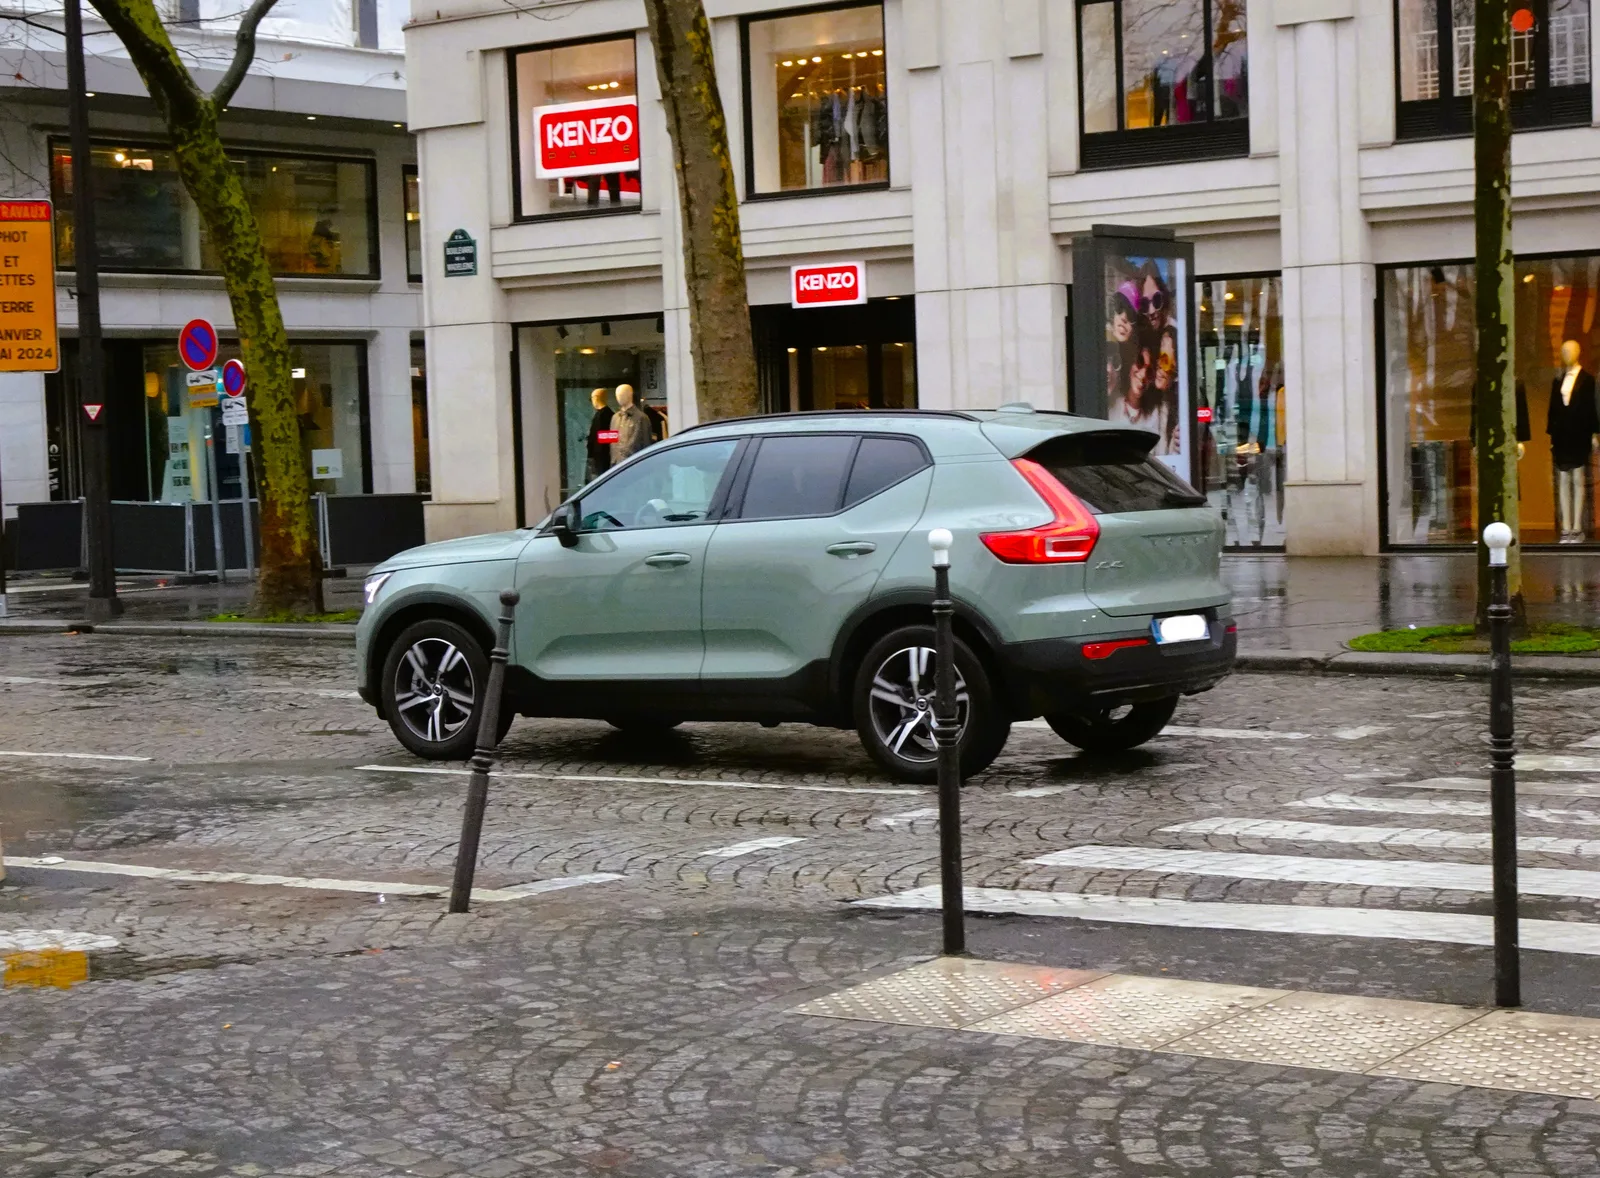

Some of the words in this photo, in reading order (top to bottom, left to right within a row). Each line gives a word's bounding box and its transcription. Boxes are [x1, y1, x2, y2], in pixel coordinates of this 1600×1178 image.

[546, 115, 633, 149] KENZO
[4, 254, 19, 268] ET
[799, 271, 856, 291] KENZO
[0, 301, 35, 313] ERRE
[17, 347, 52, 360] 2024
